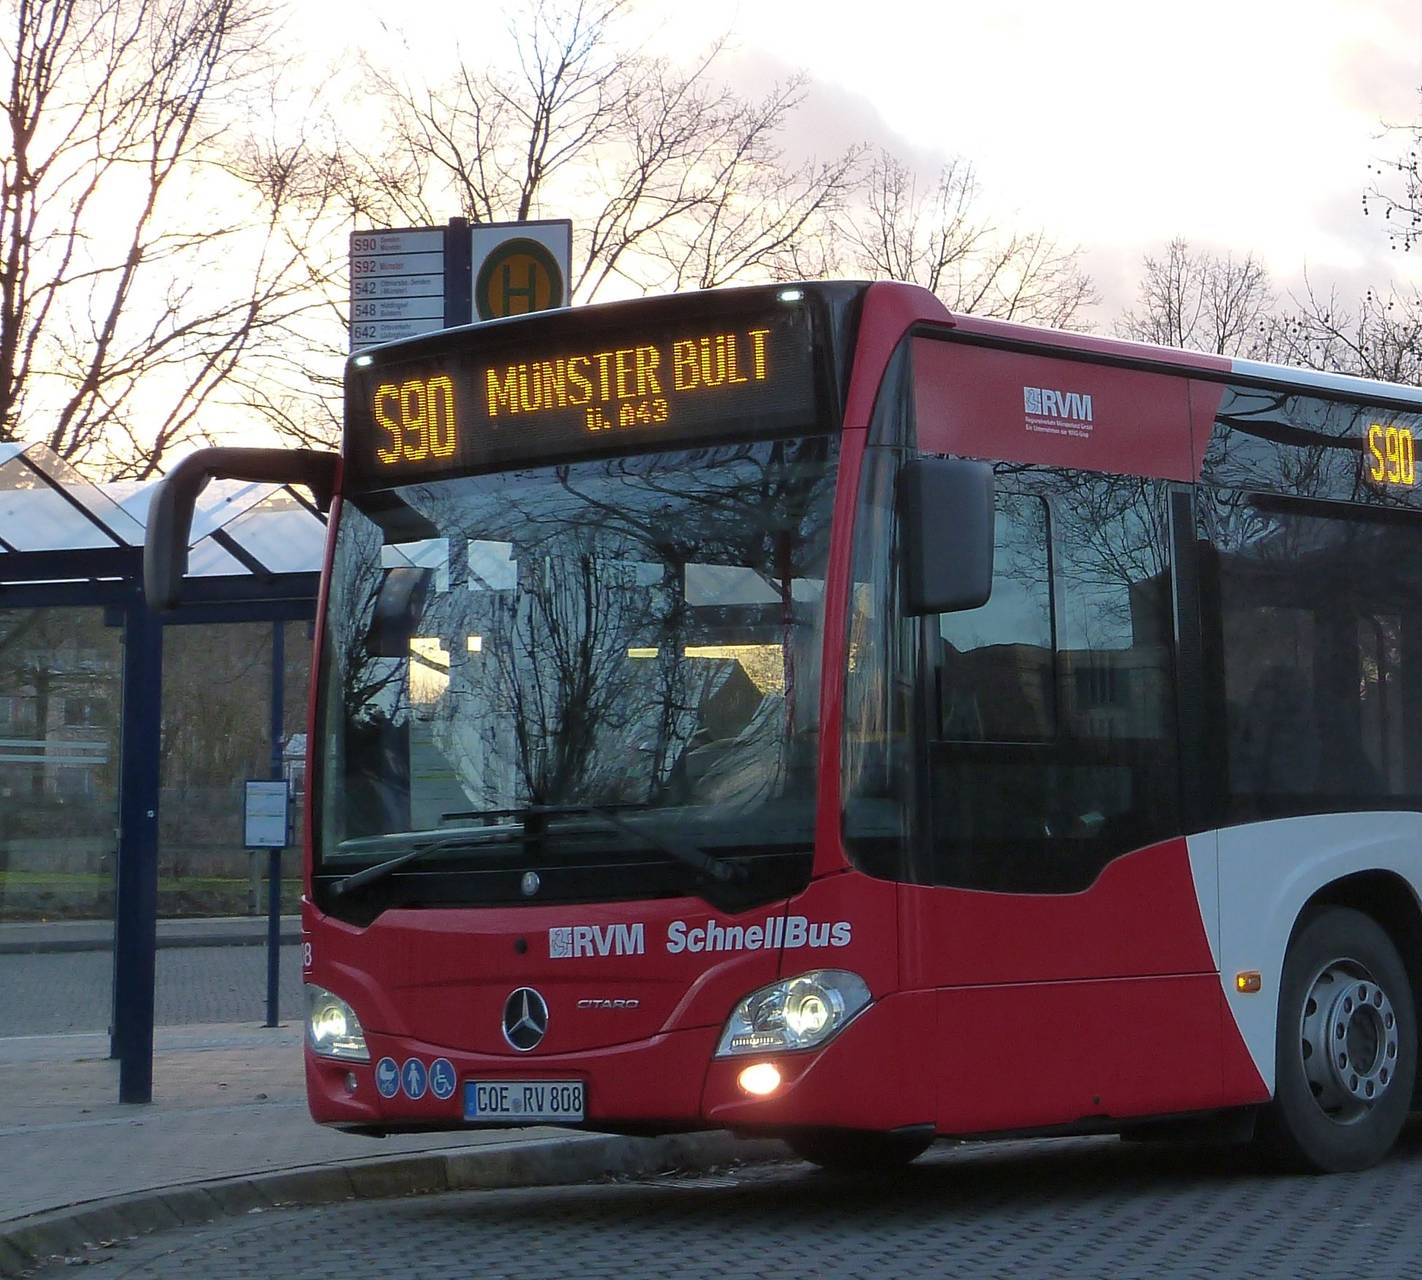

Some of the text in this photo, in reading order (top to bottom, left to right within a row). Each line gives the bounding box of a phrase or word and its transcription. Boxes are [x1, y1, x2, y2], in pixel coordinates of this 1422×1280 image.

[354, 238, 376, 252] S90
[354, 261, 376, 274] S92
[355, 304, 376, 317] 548
[354, 326, 376, 339] 642
[373, 328, 771, 465] S90 MÜNSTER BÜLT
[1041, 389, 1093, 421] RVM
[618, 398, 669, 429] A43
[1367, 423, 1415, 486] S90
[573, 916, 852, 957] RVM SchnellBus
[577, 999, 640, 1009] CITARO
[477, 1086, 582, 1112] COE RV 808
